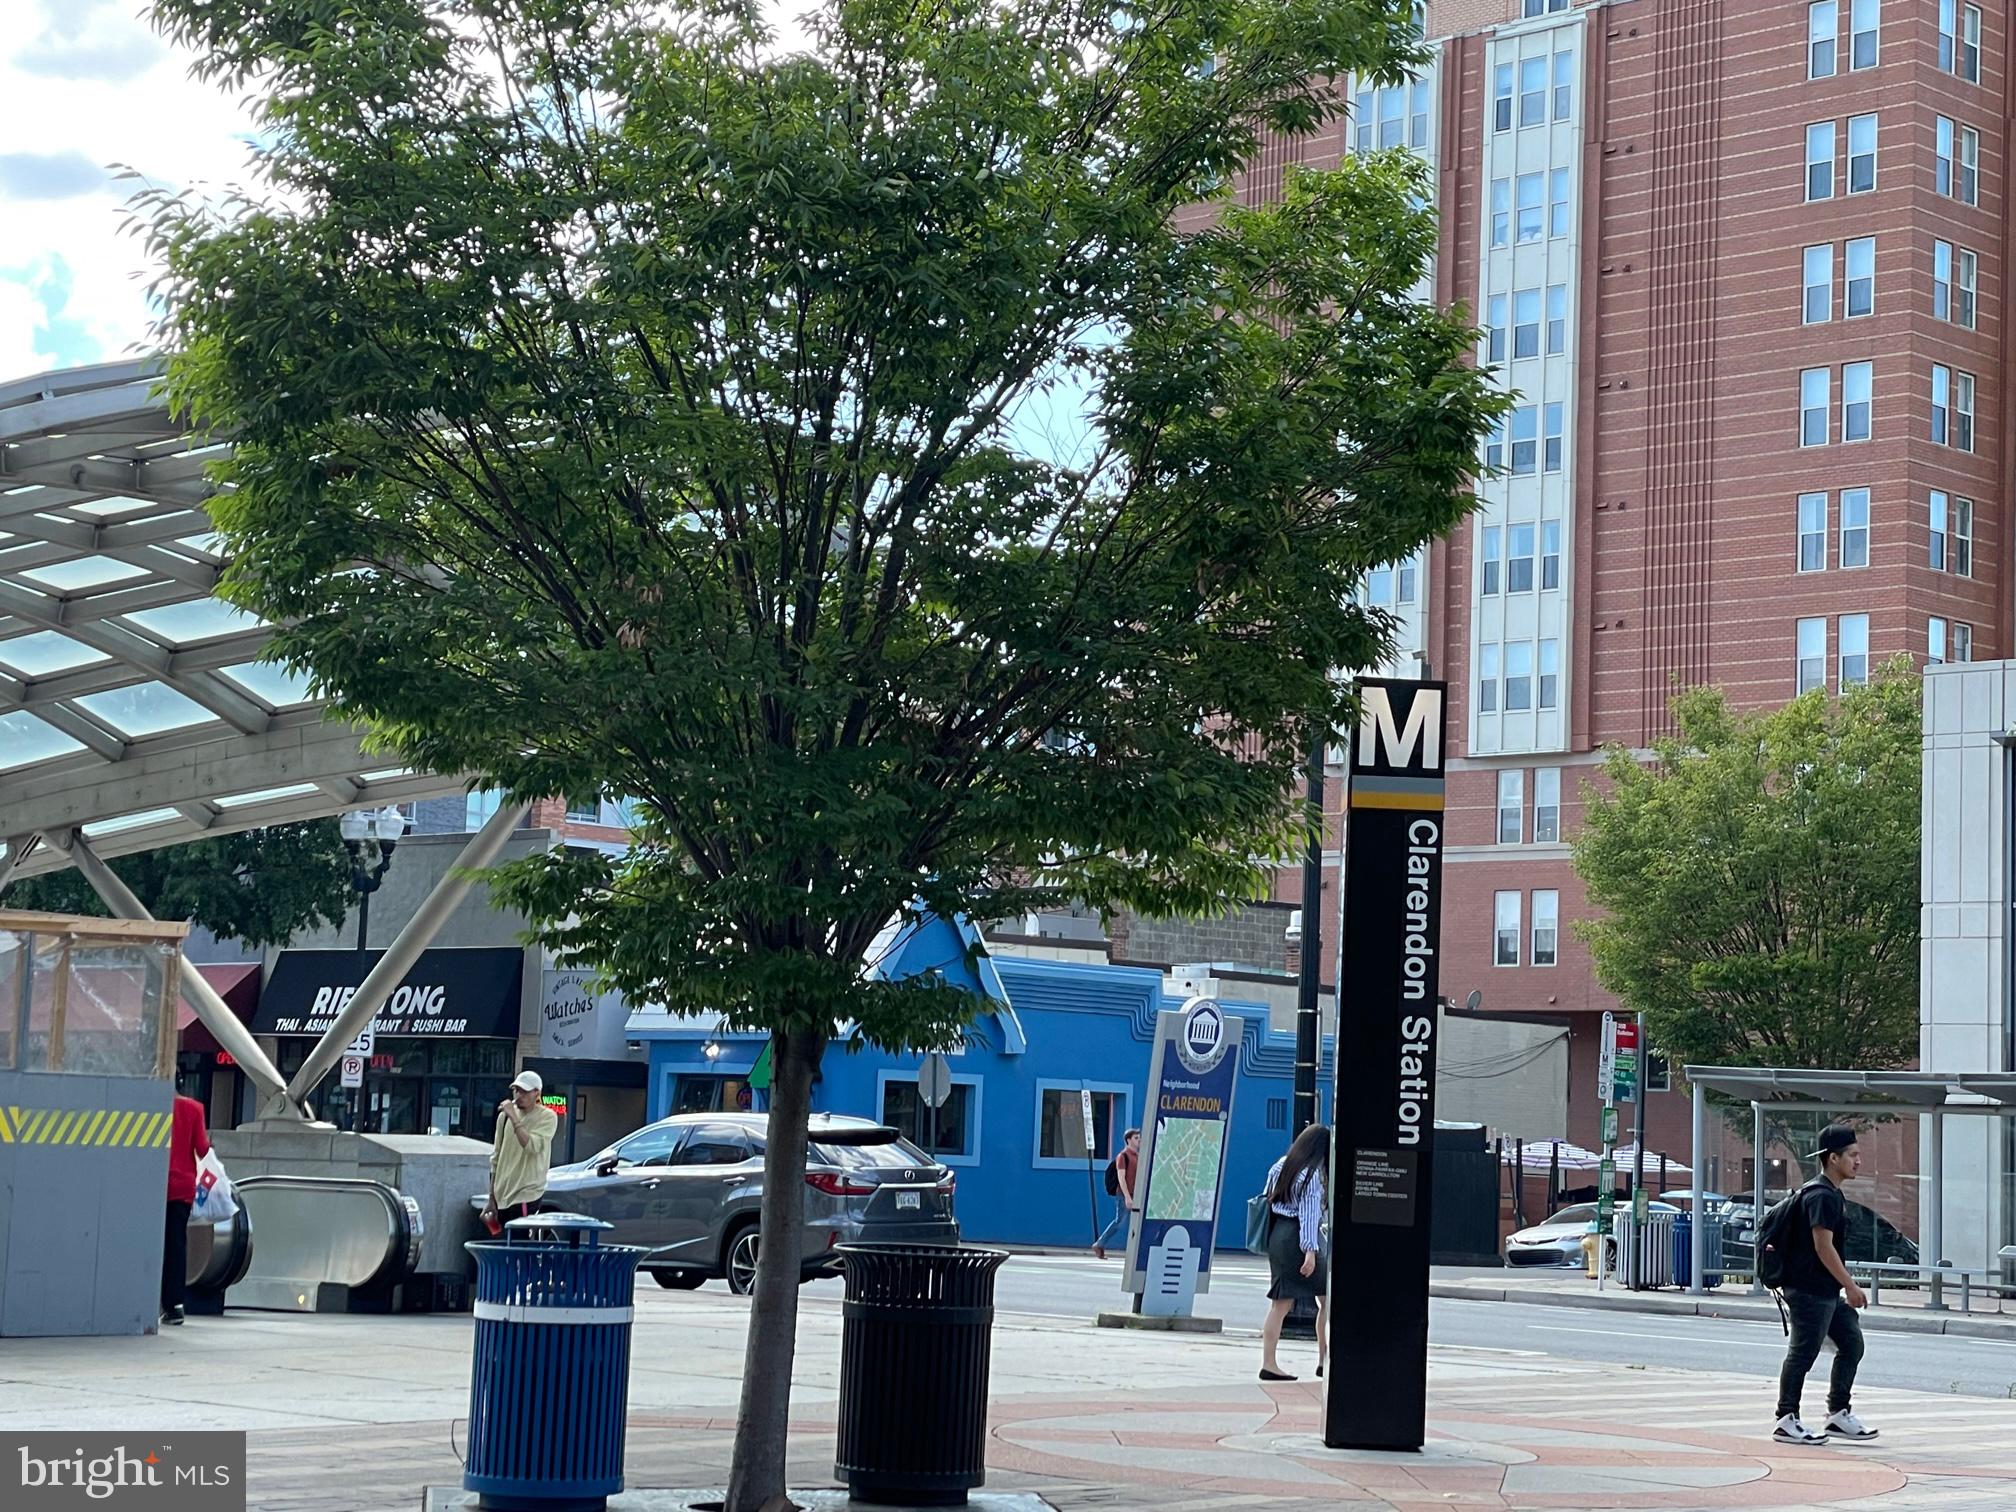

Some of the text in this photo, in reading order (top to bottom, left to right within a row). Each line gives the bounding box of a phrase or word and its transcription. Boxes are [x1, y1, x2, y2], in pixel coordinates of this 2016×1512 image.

[1358, 686, 1442, 769] M
[1398, 819, 1438, 1145] Clarendon Station
[310, 986, 356, 1015] RIE
[544, 997, 593, 1020] Watches
[275, 1018, 298, 1032] THAI
[411, 1019, 443, 1033] SUSHI
[443, 1019, 467, 1033] BAR
[1163, 1079, 1200, 1090] Neighborhood
[542, 1096, 566, 1105] WATCH
[1160, 1094, 1221, 1113] CLARENDON
